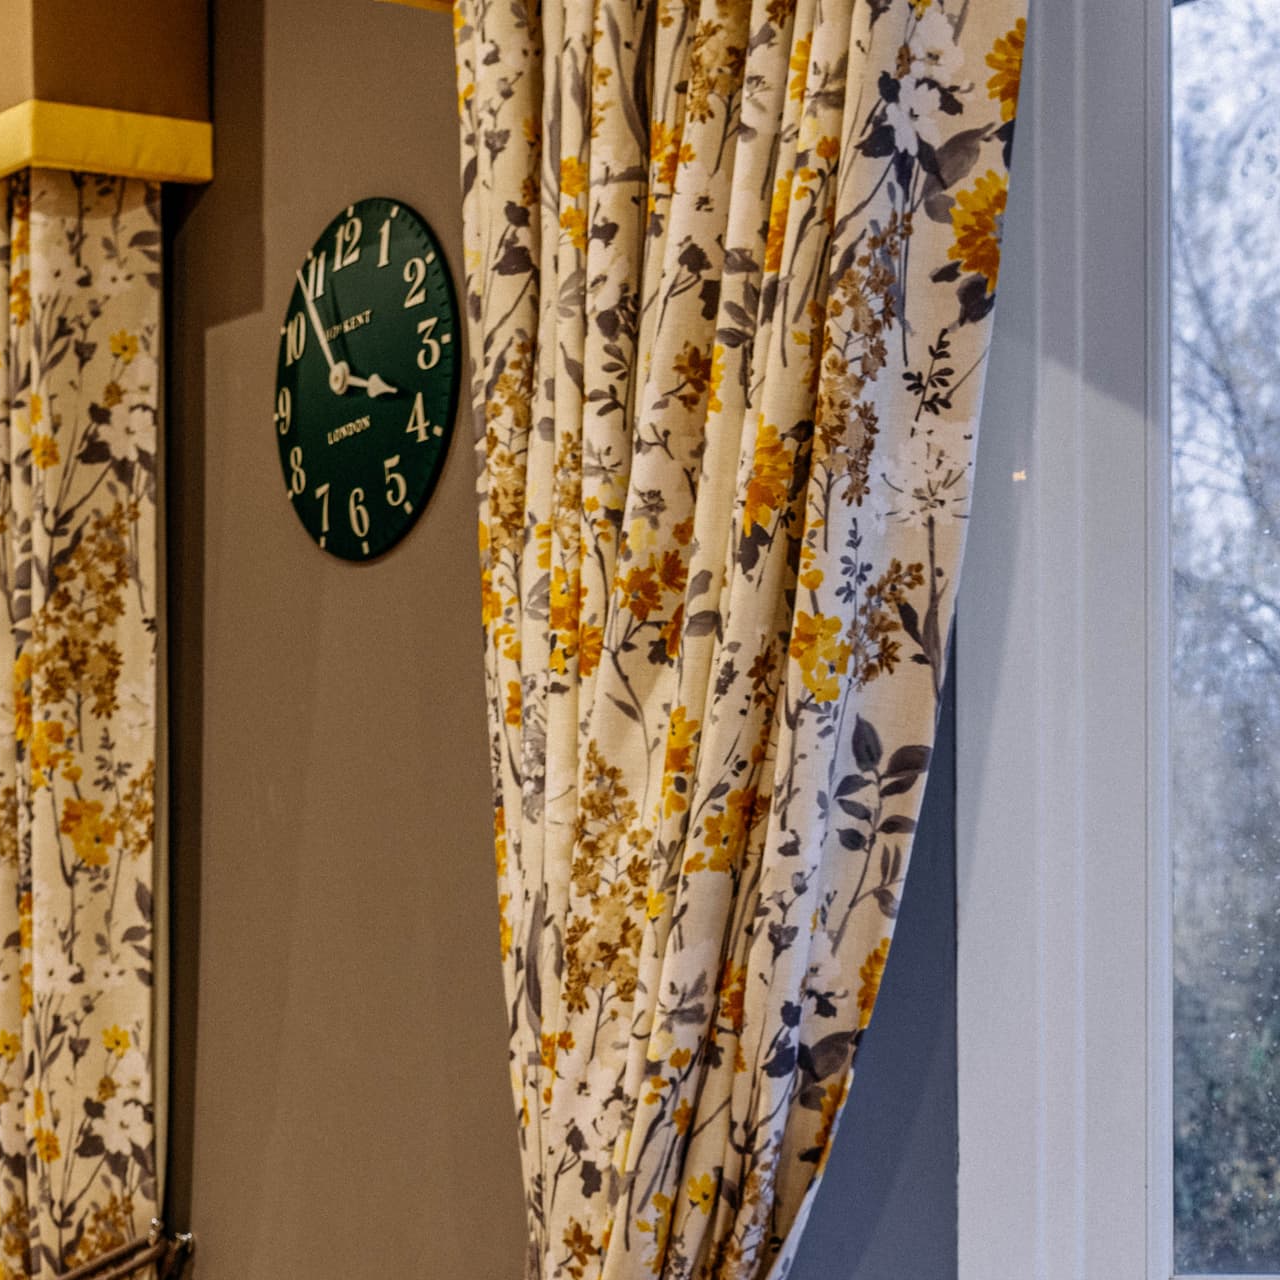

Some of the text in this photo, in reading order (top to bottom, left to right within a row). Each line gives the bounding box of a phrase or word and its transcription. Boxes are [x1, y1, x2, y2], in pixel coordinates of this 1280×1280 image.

[332, 217, 363, 272] 12
[376, 219, 391, 268] 1
[309, 251, 327, 301] 11
[403, 257, 427, 308] 2
[285, 311, 306, 368] 10
[343, 309, 372, 333] KENT
[417, 317, 441, 370] 3
[277, 387, 292, 434] 9
[327, 415, 371, 445] LONDON
[406, 392, 430, 443] 4
[290, 446, 306, 495] 8
[384, 455, 407, 506] 5
[315, 483, 330, 532] 7
[348, 487, 370, 538] 6
